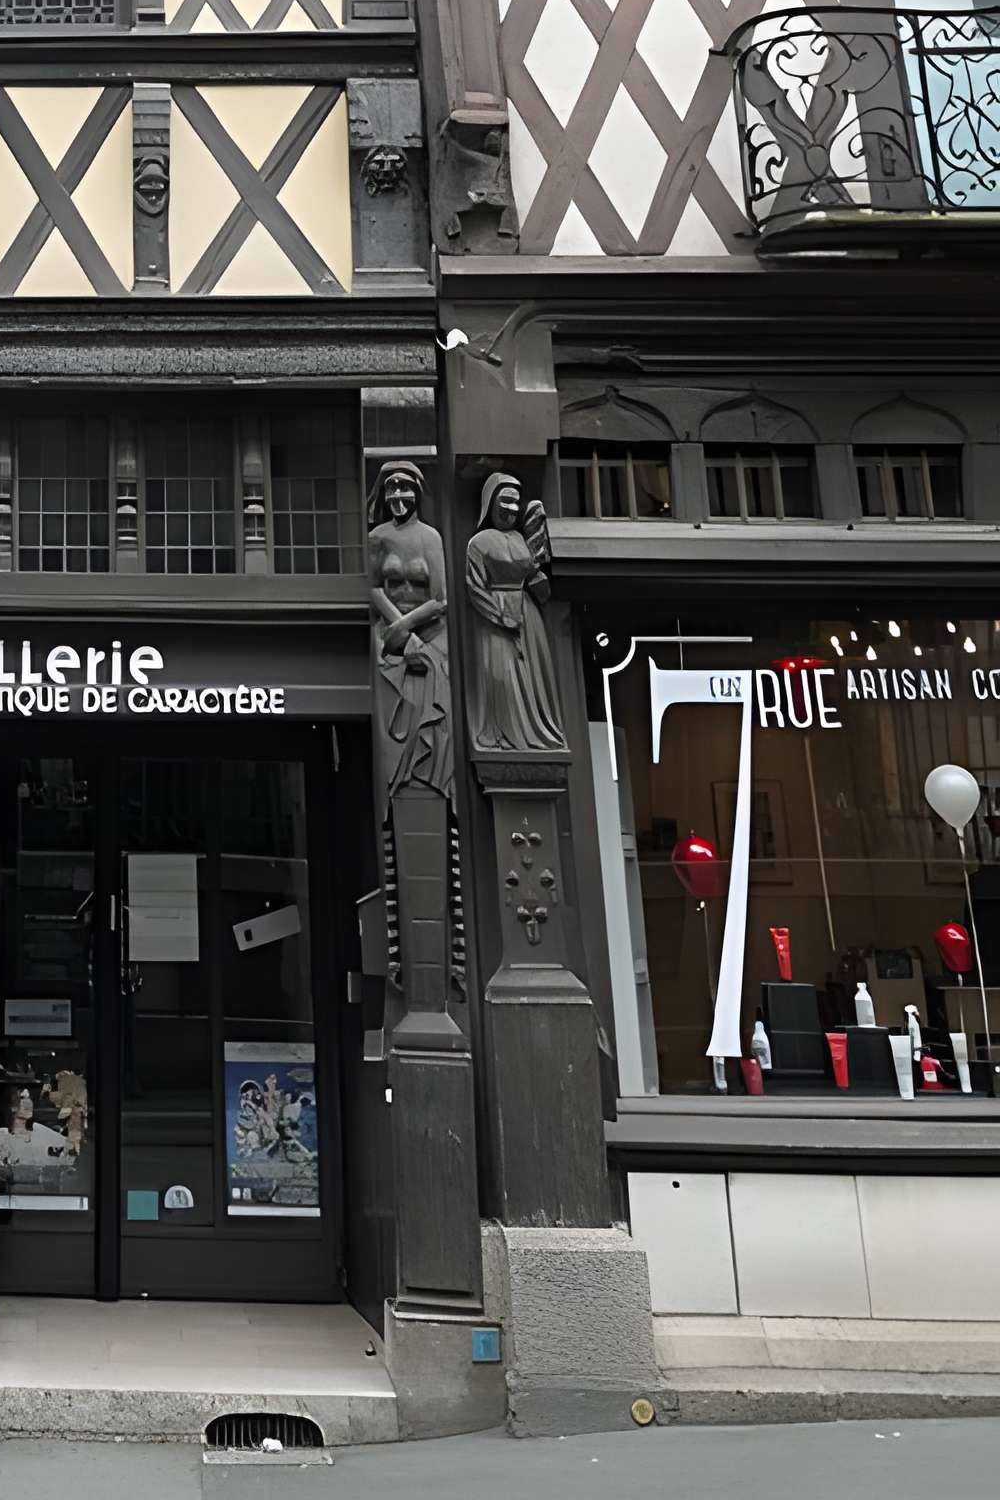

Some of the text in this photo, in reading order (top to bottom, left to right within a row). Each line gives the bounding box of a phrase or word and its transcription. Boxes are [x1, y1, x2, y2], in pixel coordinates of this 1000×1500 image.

[82, 686, 118, 713] DE
[127, 682, 286, 714] CARACTÈRE
[648, 656, 753, 1058] 7
[755, 668, 842, 729] RUE
[846, 668, 953, 700] ARTISAN
